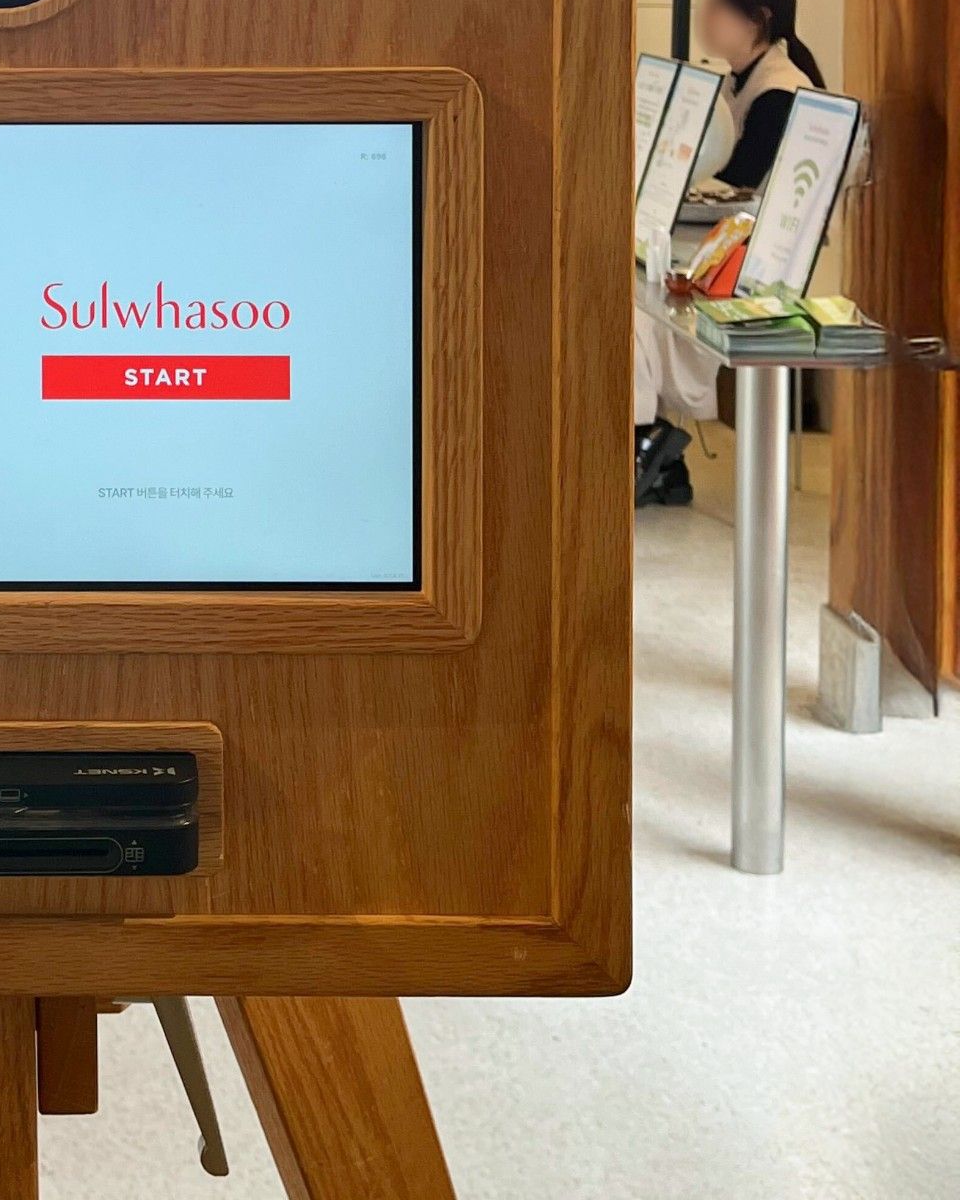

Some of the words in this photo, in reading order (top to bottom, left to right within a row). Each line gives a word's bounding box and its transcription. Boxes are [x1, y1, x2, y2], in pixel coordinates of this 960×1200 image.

[41, 280, 291, 330] Sulwhasoo
[124, 368, 207, 387] START
[98, 487, 134, 499] START
[136, 487, 167, 499] 버튼을
[169, 487, 201, 499] 터치해
[203, 487, 234, 499] 주세요
[73, 768, 147, 776] KSNET
